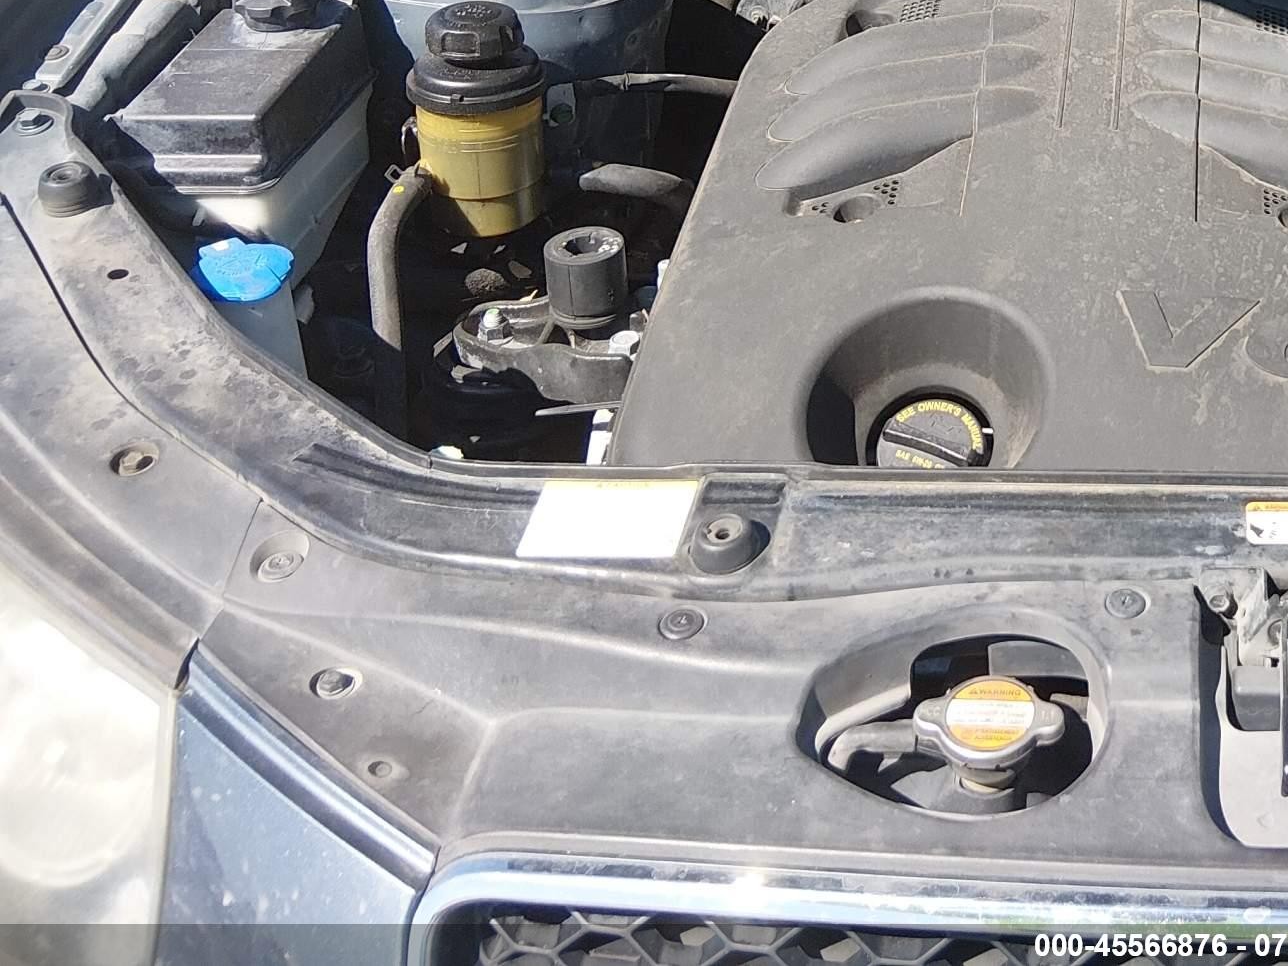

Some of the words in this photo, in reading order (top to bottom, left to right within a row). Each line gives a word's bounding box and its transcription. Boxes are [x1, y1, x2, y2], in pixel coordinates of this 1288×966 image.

[897, 406, 915, 423] SEE
[917, 401, 961, 416] OWNER'S
[961, 413, 983, 450] MANUAL
